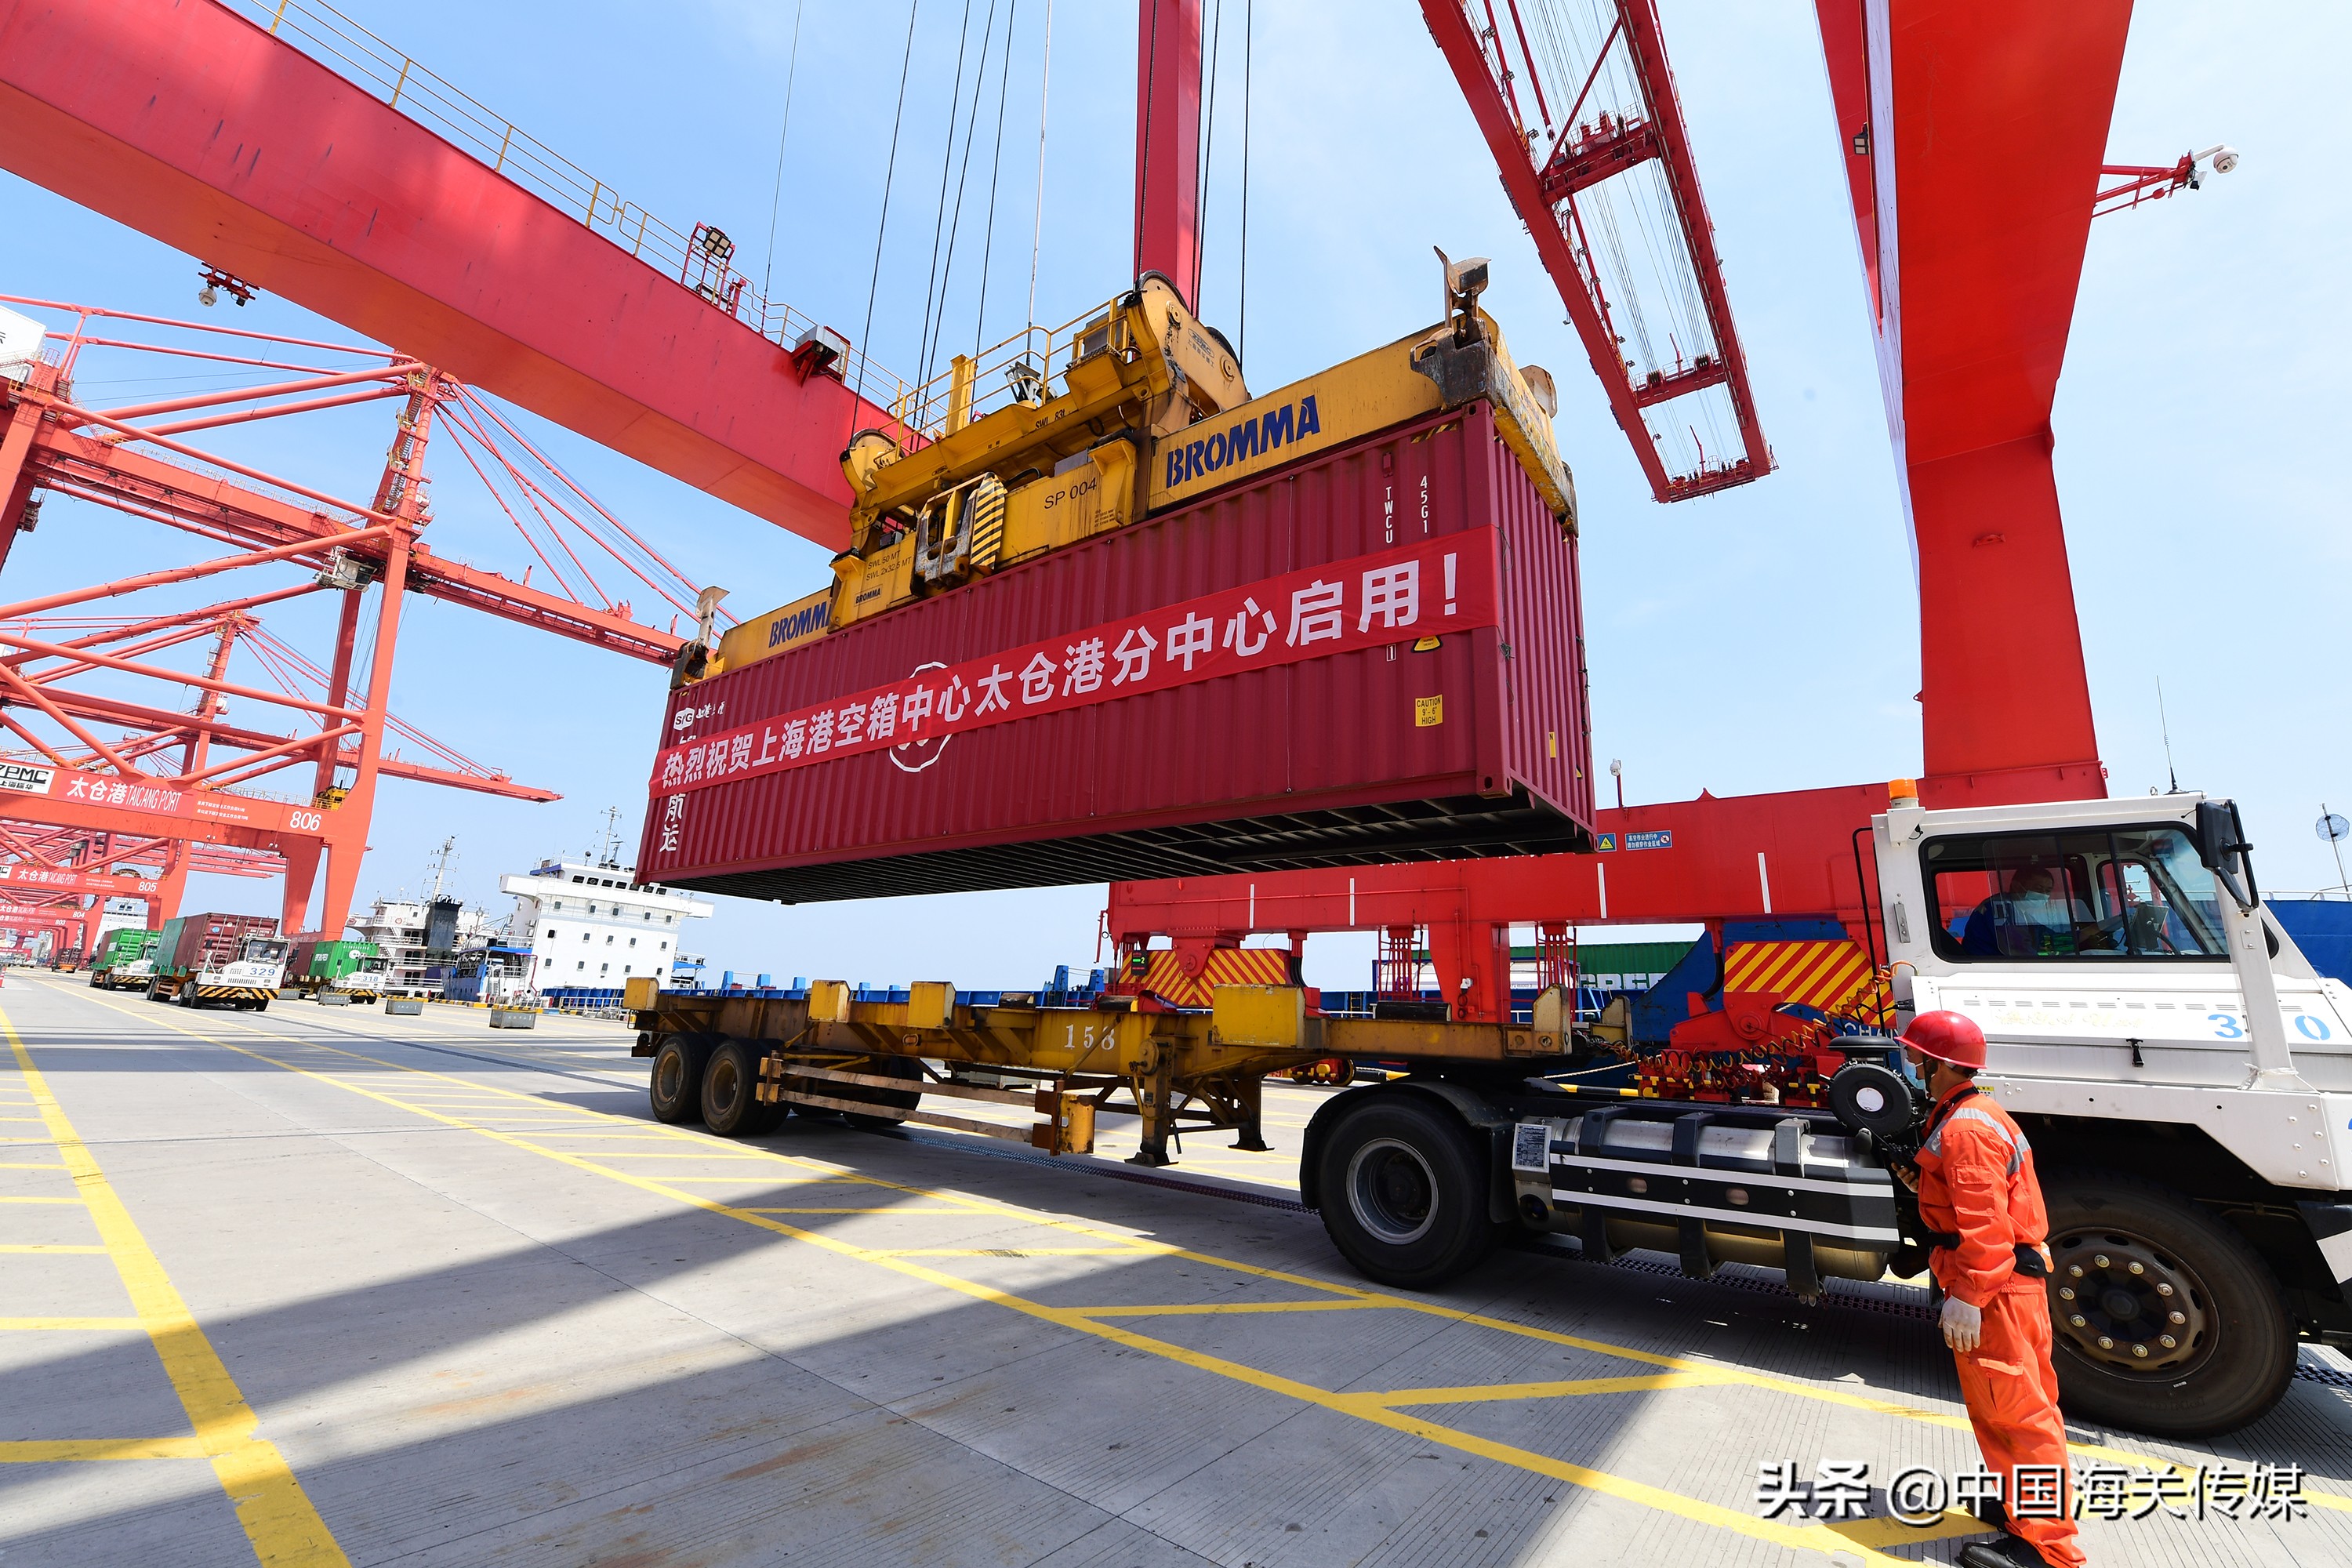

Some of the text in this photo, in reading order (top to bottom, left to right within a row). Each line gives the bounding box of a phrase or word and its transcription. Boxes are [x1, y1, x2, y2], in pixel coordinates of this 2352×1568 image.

[1166, 394, 1320, 489] BROMMA
[1044, 477, 1097, 510] SP 004
[1420, 475, 1428, 534] 45G1
[1384, 486, 1394, 543] TWCU
[866, 570, 880, 581] SWL
[901, 557, 912, 568] MT
[867, 550, 900, 570] SWL 50 MT
[855, 588, 881, 604] BROMMA
[768, 601, 832, 648] BROMM
[1416, 698, 1441, 708] CAUTION
[1421, 716, 1436, 725] HIGH
[67, 777, 183, 812] 太仓港 TAICANG PORT
[289, 811, 322, 832] 806
[17, 869, 49, 883] 太仓港
[64, 873, 78, 885] PORT
[138, 880, 158, 892] 805
[250, 967, 275, 976] 329
[2207, 1014, 2332, 1041] 30
